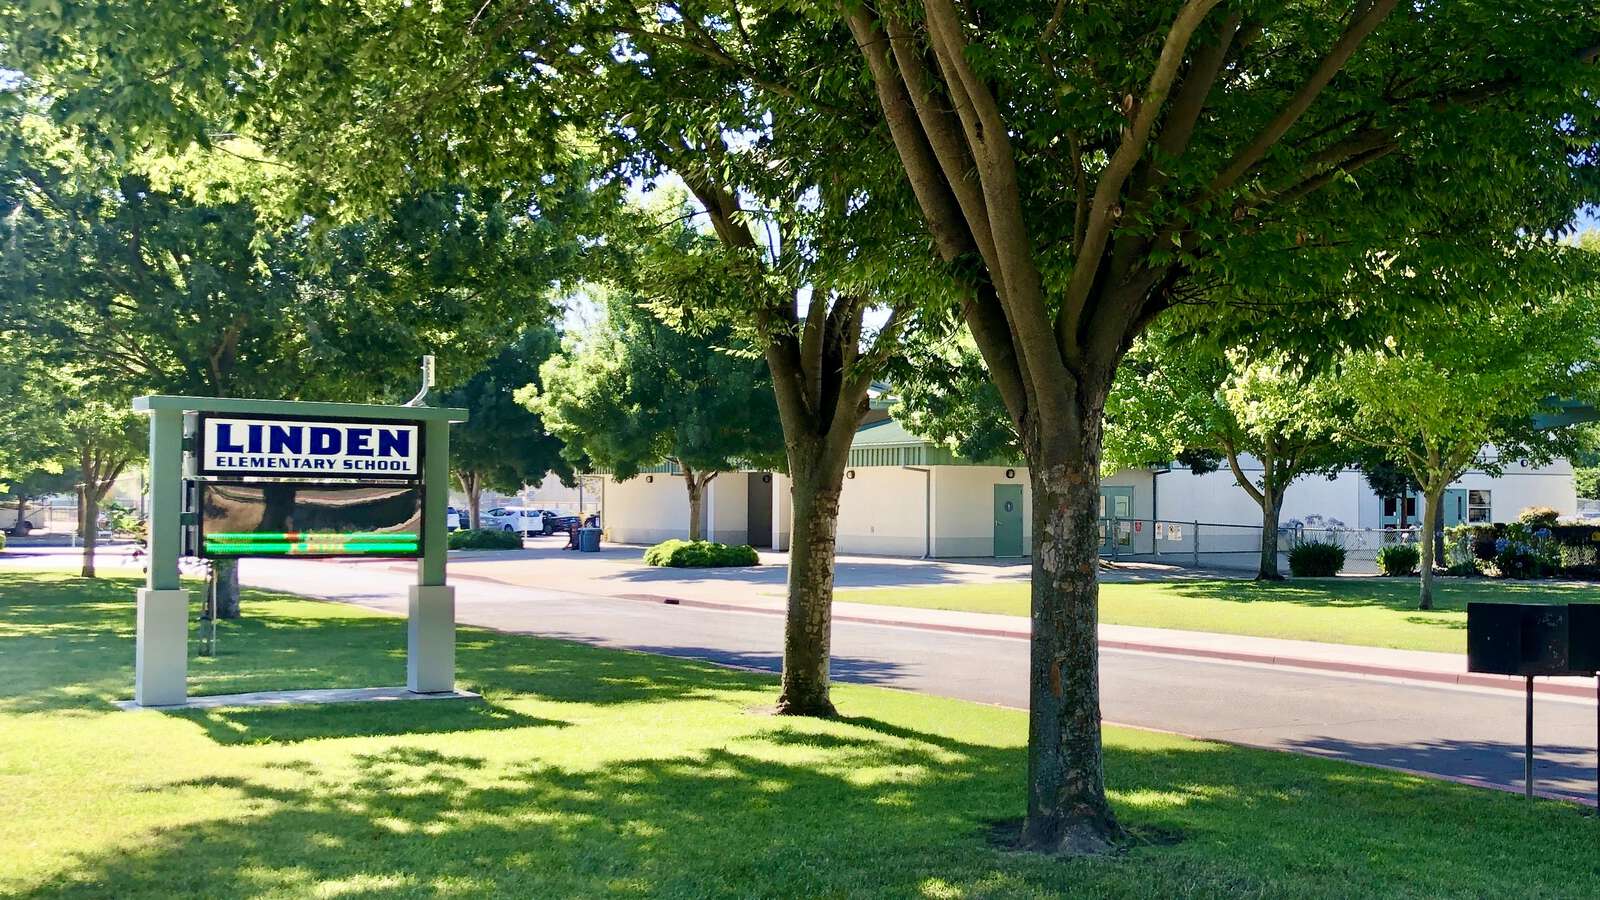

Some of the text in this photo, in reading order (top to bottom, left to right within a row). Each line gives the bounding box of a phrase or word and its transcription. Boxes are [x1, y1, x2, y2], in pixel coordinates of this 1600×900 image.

[215, 423, 410, 458] LINDEN
[216, 456, 411, 471] ELEMENTARY SCHOOL
